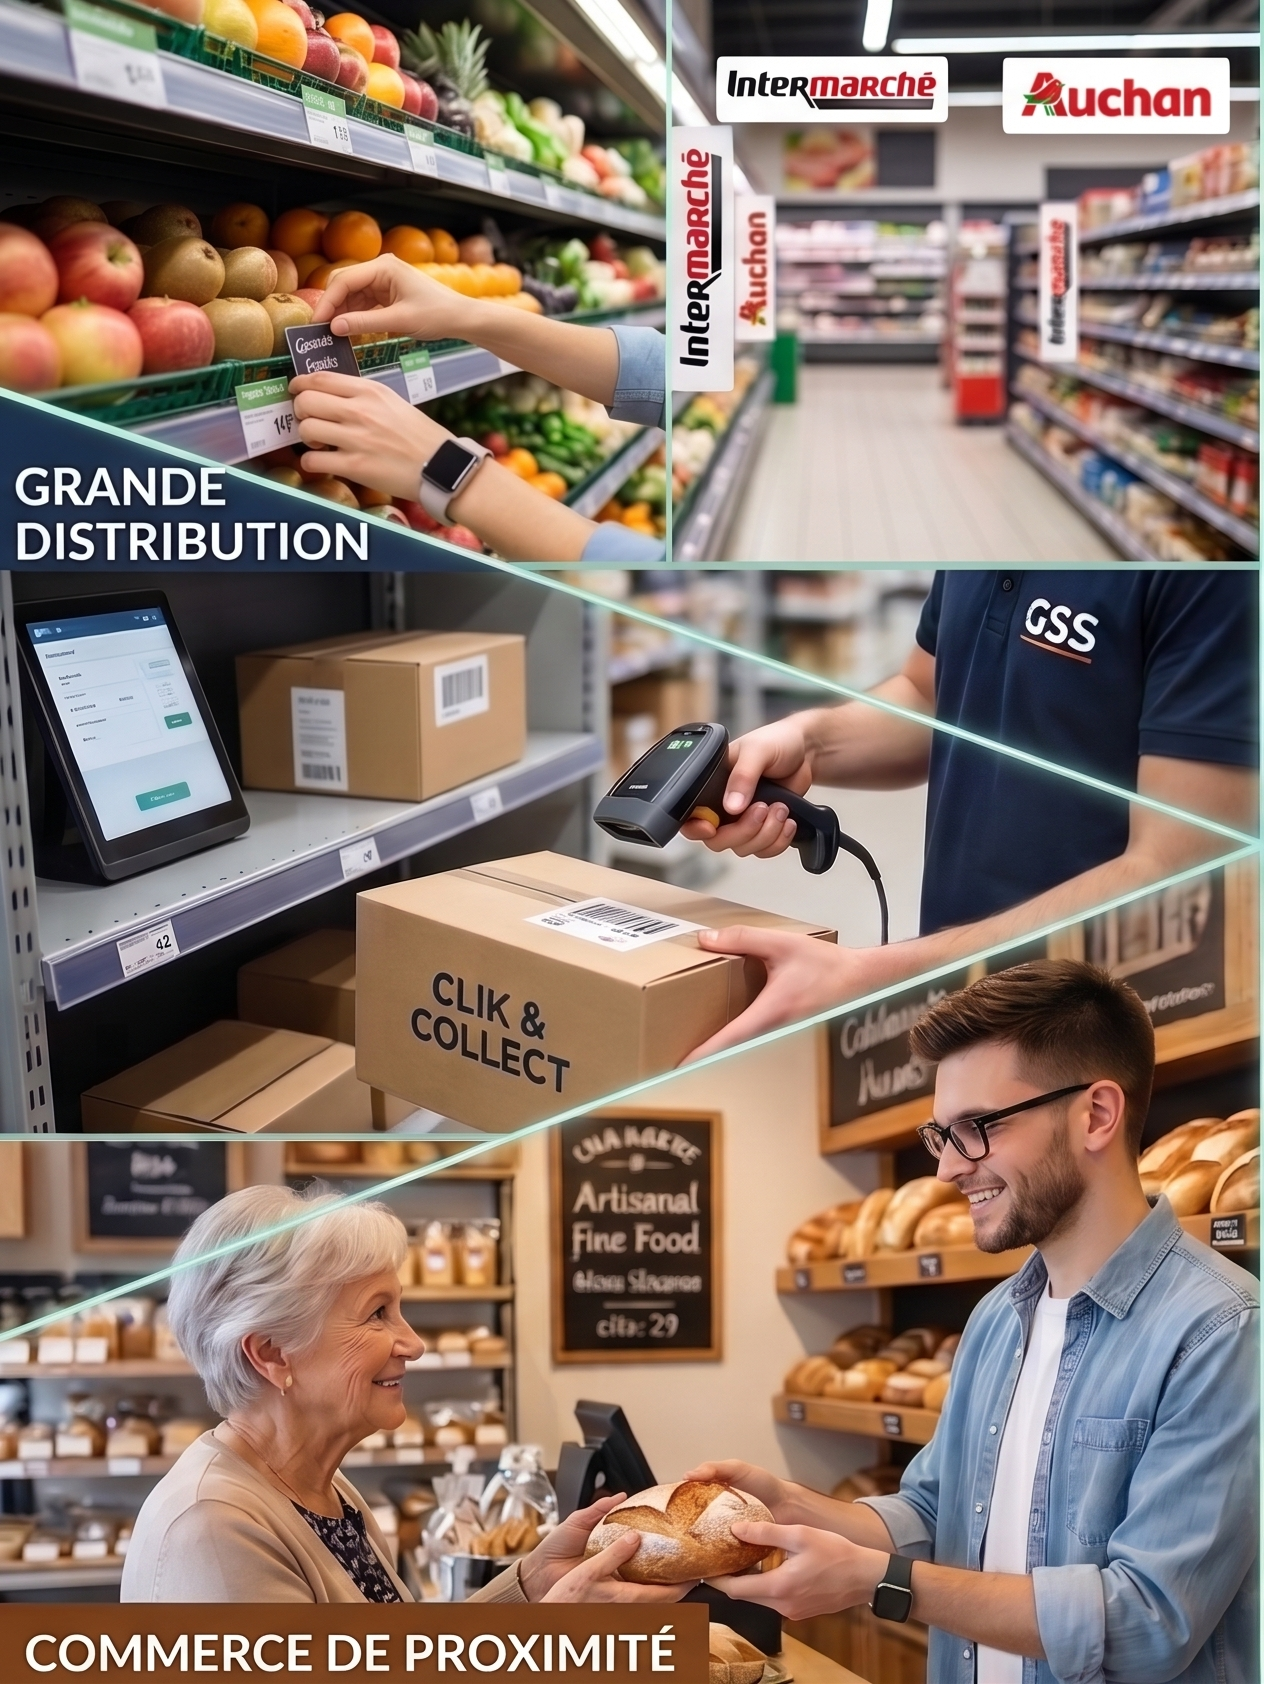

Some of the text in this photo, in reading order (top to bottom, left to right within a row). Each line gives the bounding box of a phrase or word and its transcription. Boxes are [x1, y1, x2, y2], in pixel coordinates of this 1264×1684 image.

[728, 71, 936, 109] Intermarché
[1021, 72, 1212, 117] Auchan
[680, 149, 722, 367] Intermarché
[739, 211, 768, 326] Auchan
[1025, 598, 1099, 652] GSS
[432, 972, 546, 1040] CLIK &
[411, 1008, 570, 1093] COLLECT
[571, 1180, 701, 1214] Artisanal
[571, 1219, 701, 1262] Fine Food
